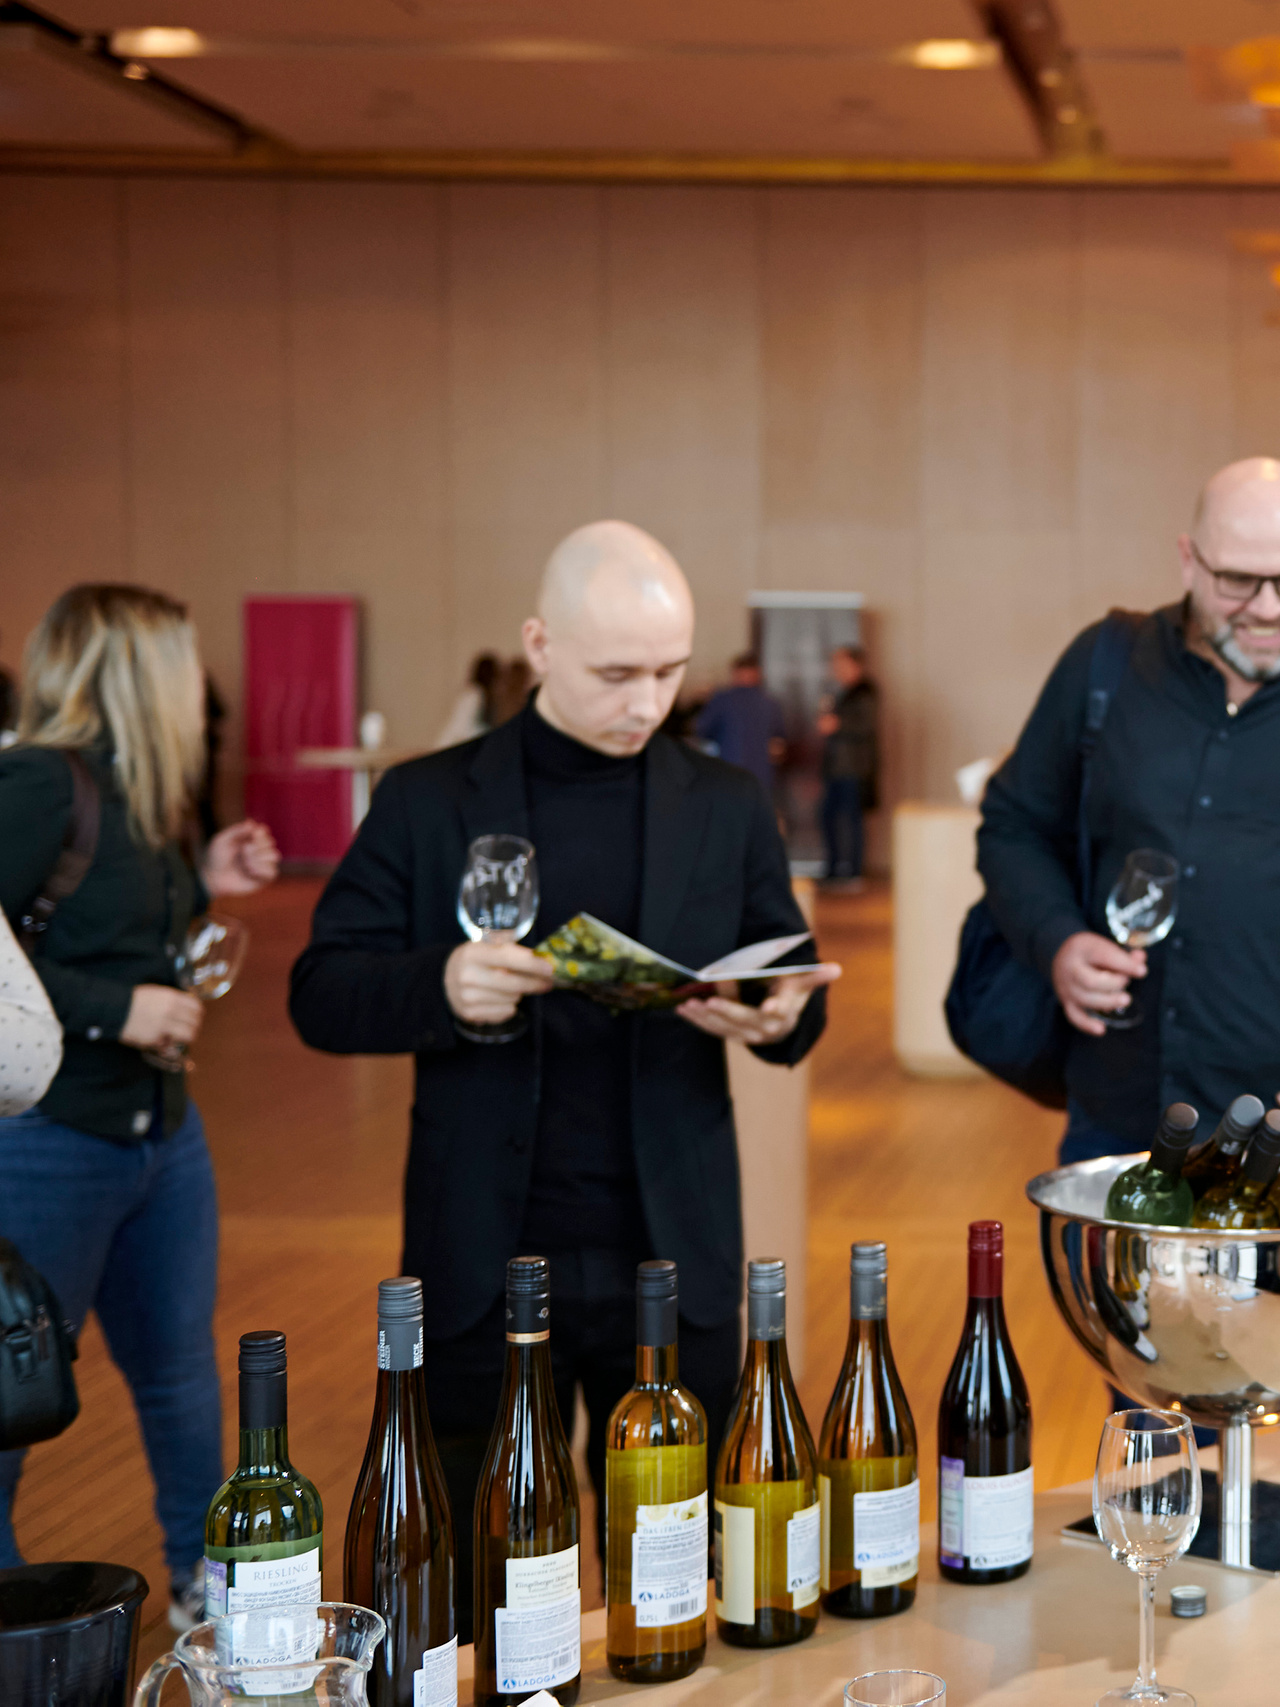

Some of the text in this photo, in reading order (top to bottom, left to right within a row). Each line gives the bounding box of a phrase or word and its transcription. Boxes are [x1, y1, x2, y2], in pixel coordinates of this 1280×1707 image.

[253, 1562, 309, 1581] RIESLING
[269, 1578, 297, 1588] TROCKEN
[654, 1588, 690, 1600] LADOGA
[250, 1655, 292, 1665] LADOGA
[518, 1674, 556, 1687] LADOGA
